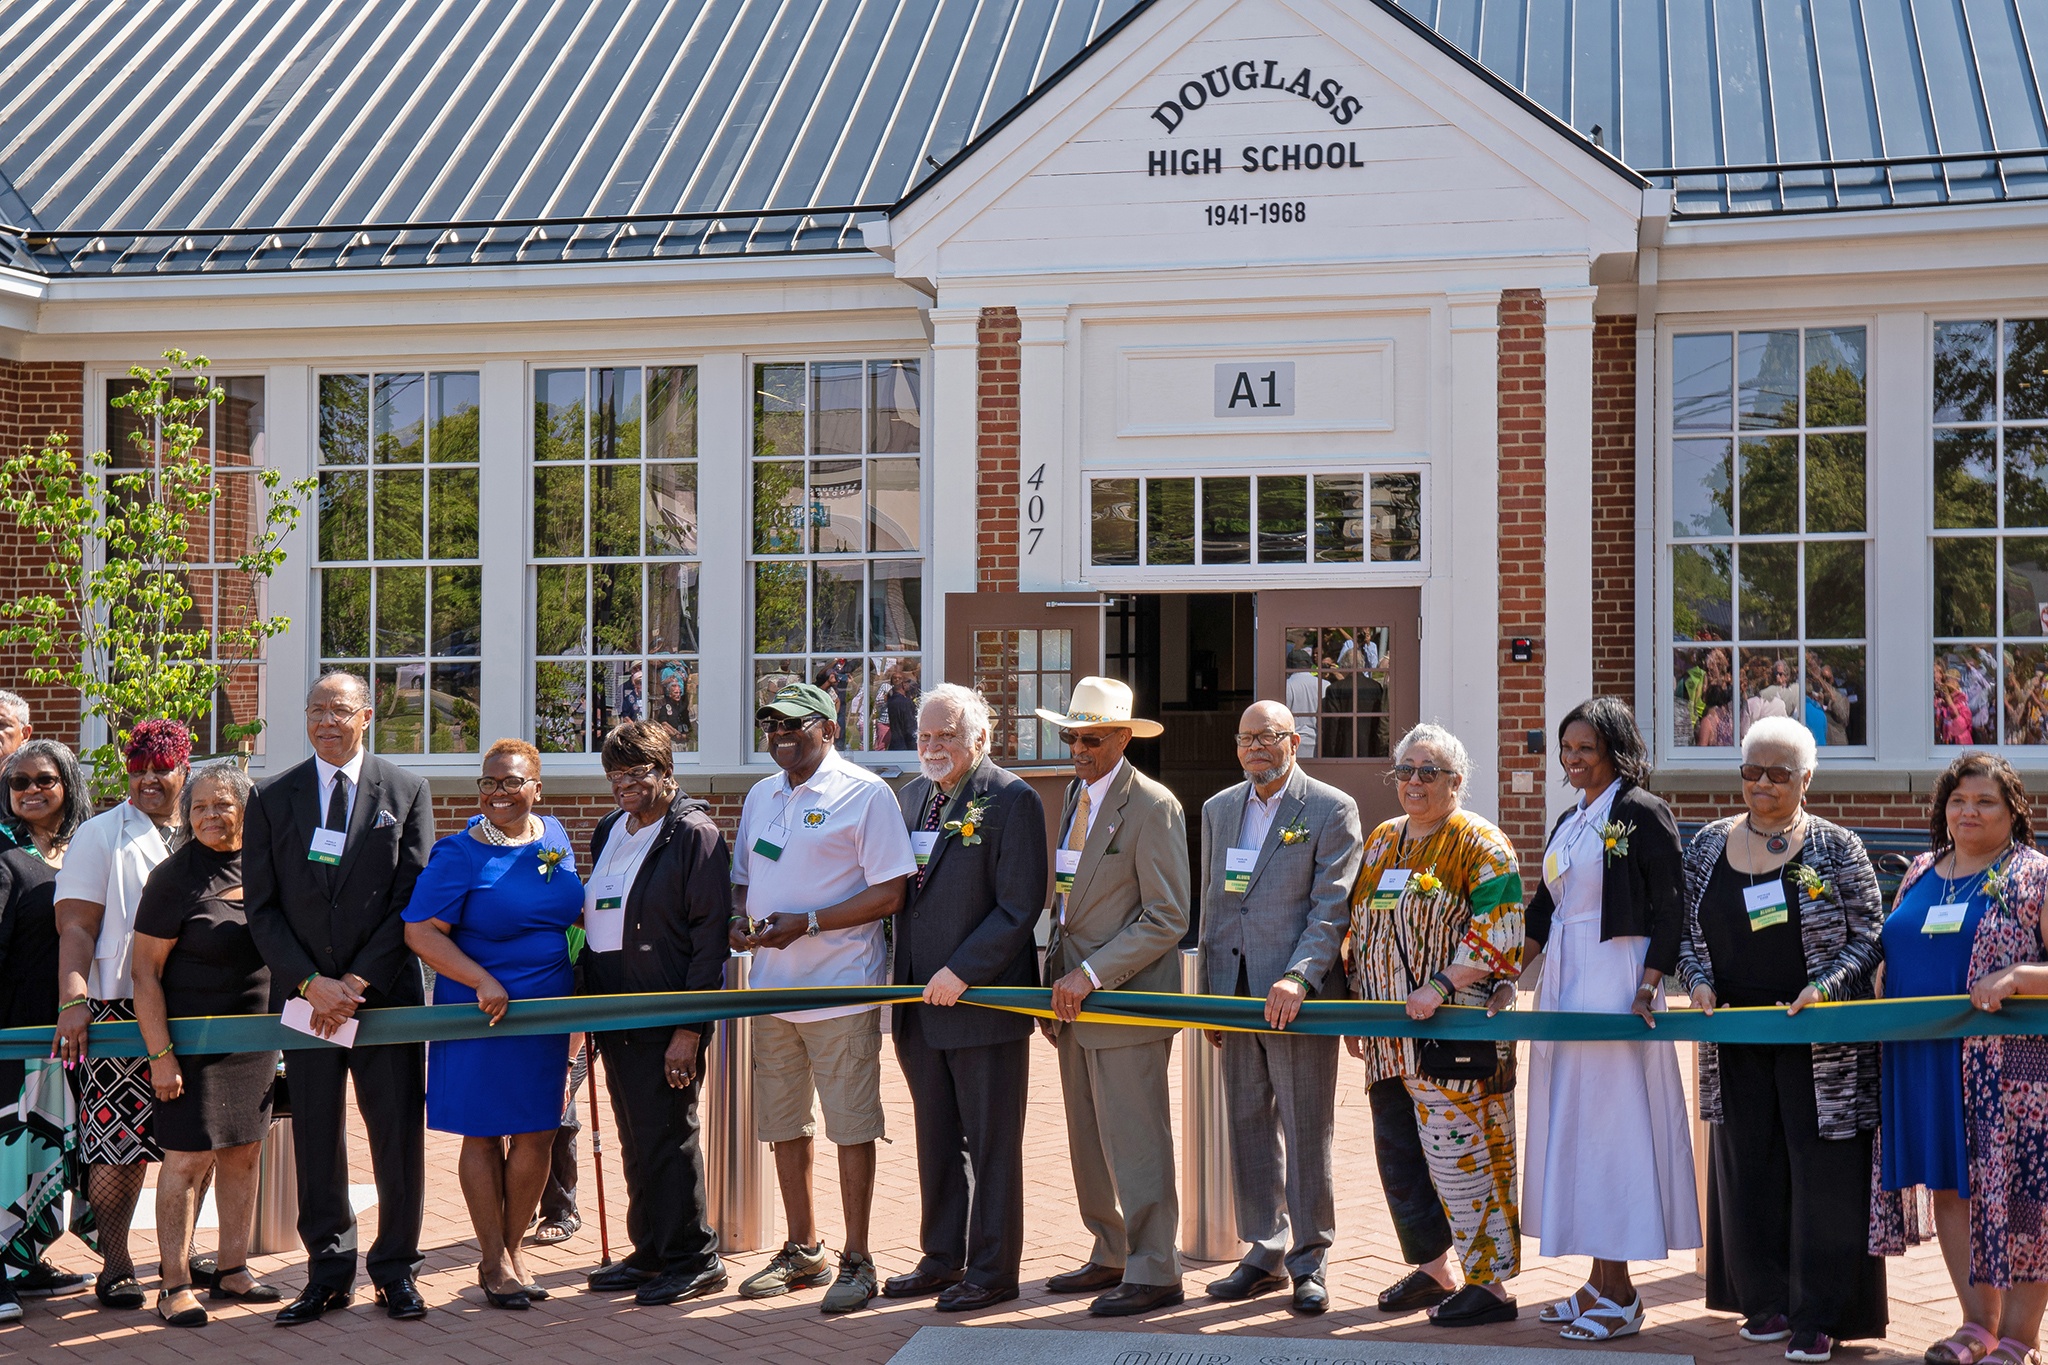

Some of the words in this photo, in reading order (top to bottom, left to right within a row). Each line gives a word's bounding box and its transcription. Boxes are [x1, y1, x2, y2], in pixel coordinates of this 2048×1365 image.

[1150, 60, 1363, 134] DOUGLASS
[1148, 148, 1222, 176] HIGH
[1241, 142, 1364, 172] SCHOOL
[1205, 202, 1306, 226] 1941-1968
[1228, 370, 1281, 408] A1
[1027, 463, 1046, 555] 407
